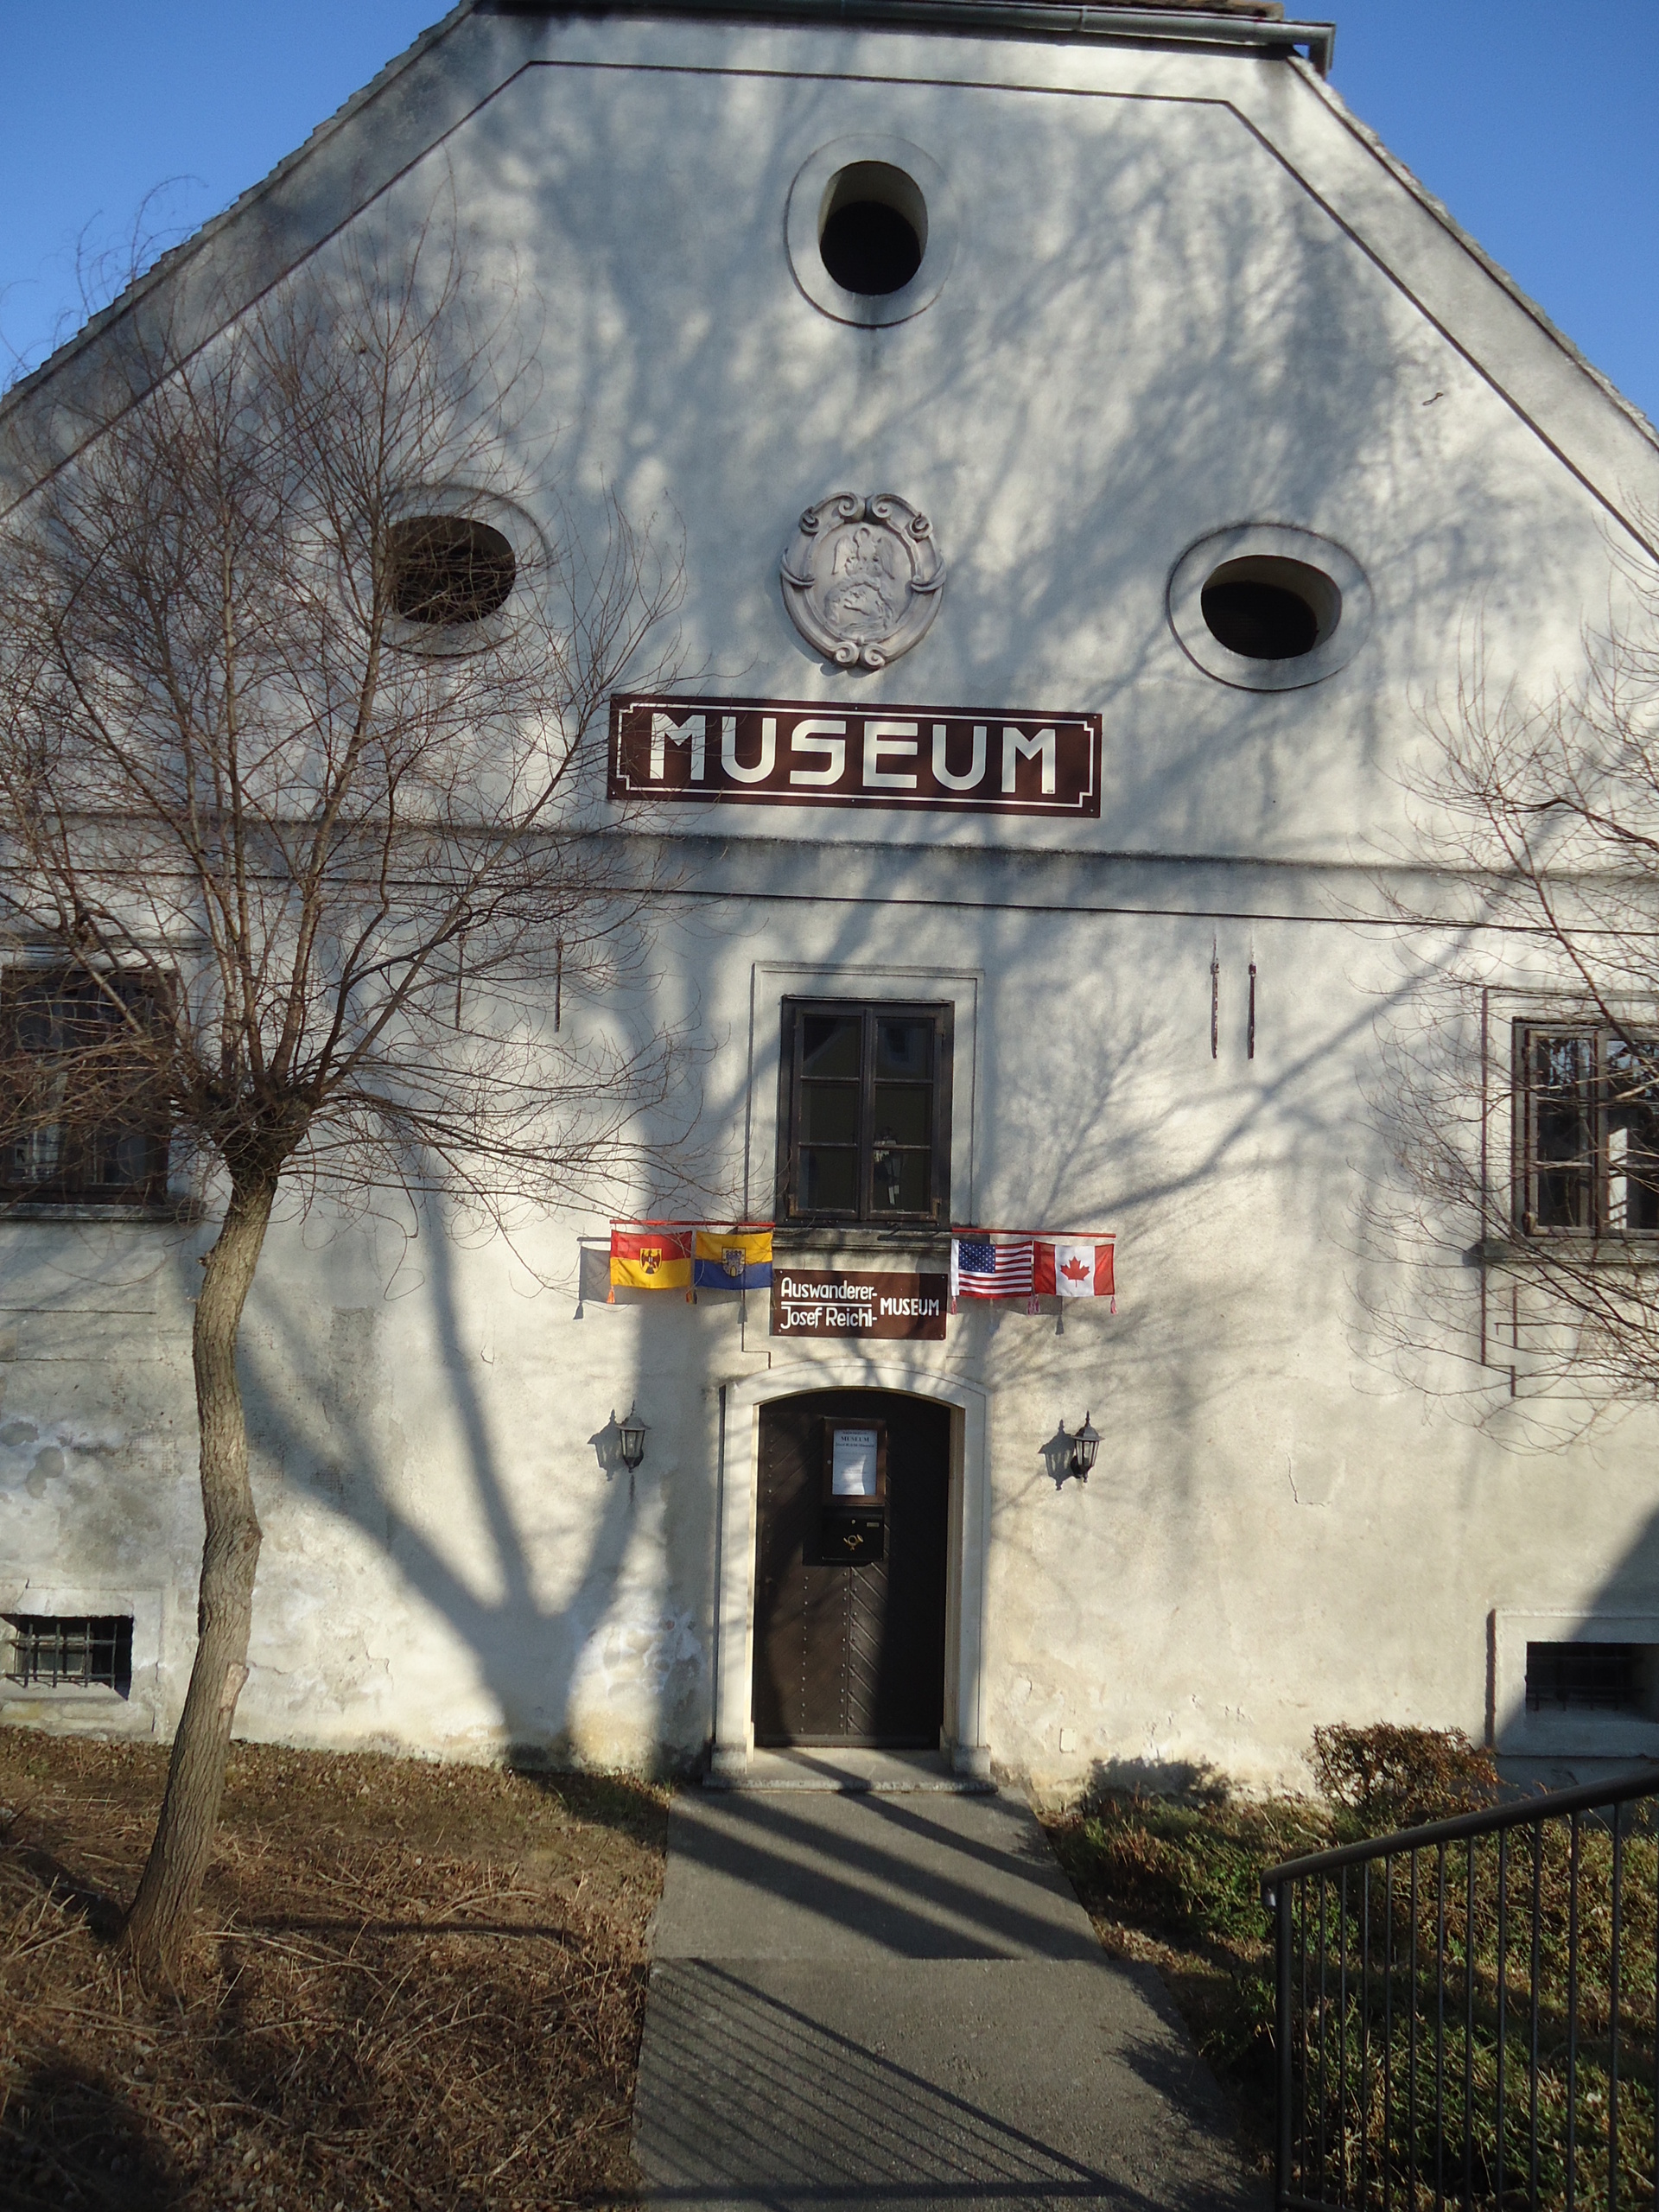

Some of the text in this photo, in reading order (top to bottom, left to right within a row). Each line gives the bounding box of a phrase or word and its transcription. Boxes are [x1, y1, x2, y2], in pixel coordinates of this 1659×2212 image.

[650, 713, 1056, 795] MUSEUM
[780, 1276, 878, 1300] Auswanderer-
[780, 1306, 878, 1330] Josef Reichl-
[880, 1297, 940, 1317] MUSEUM
